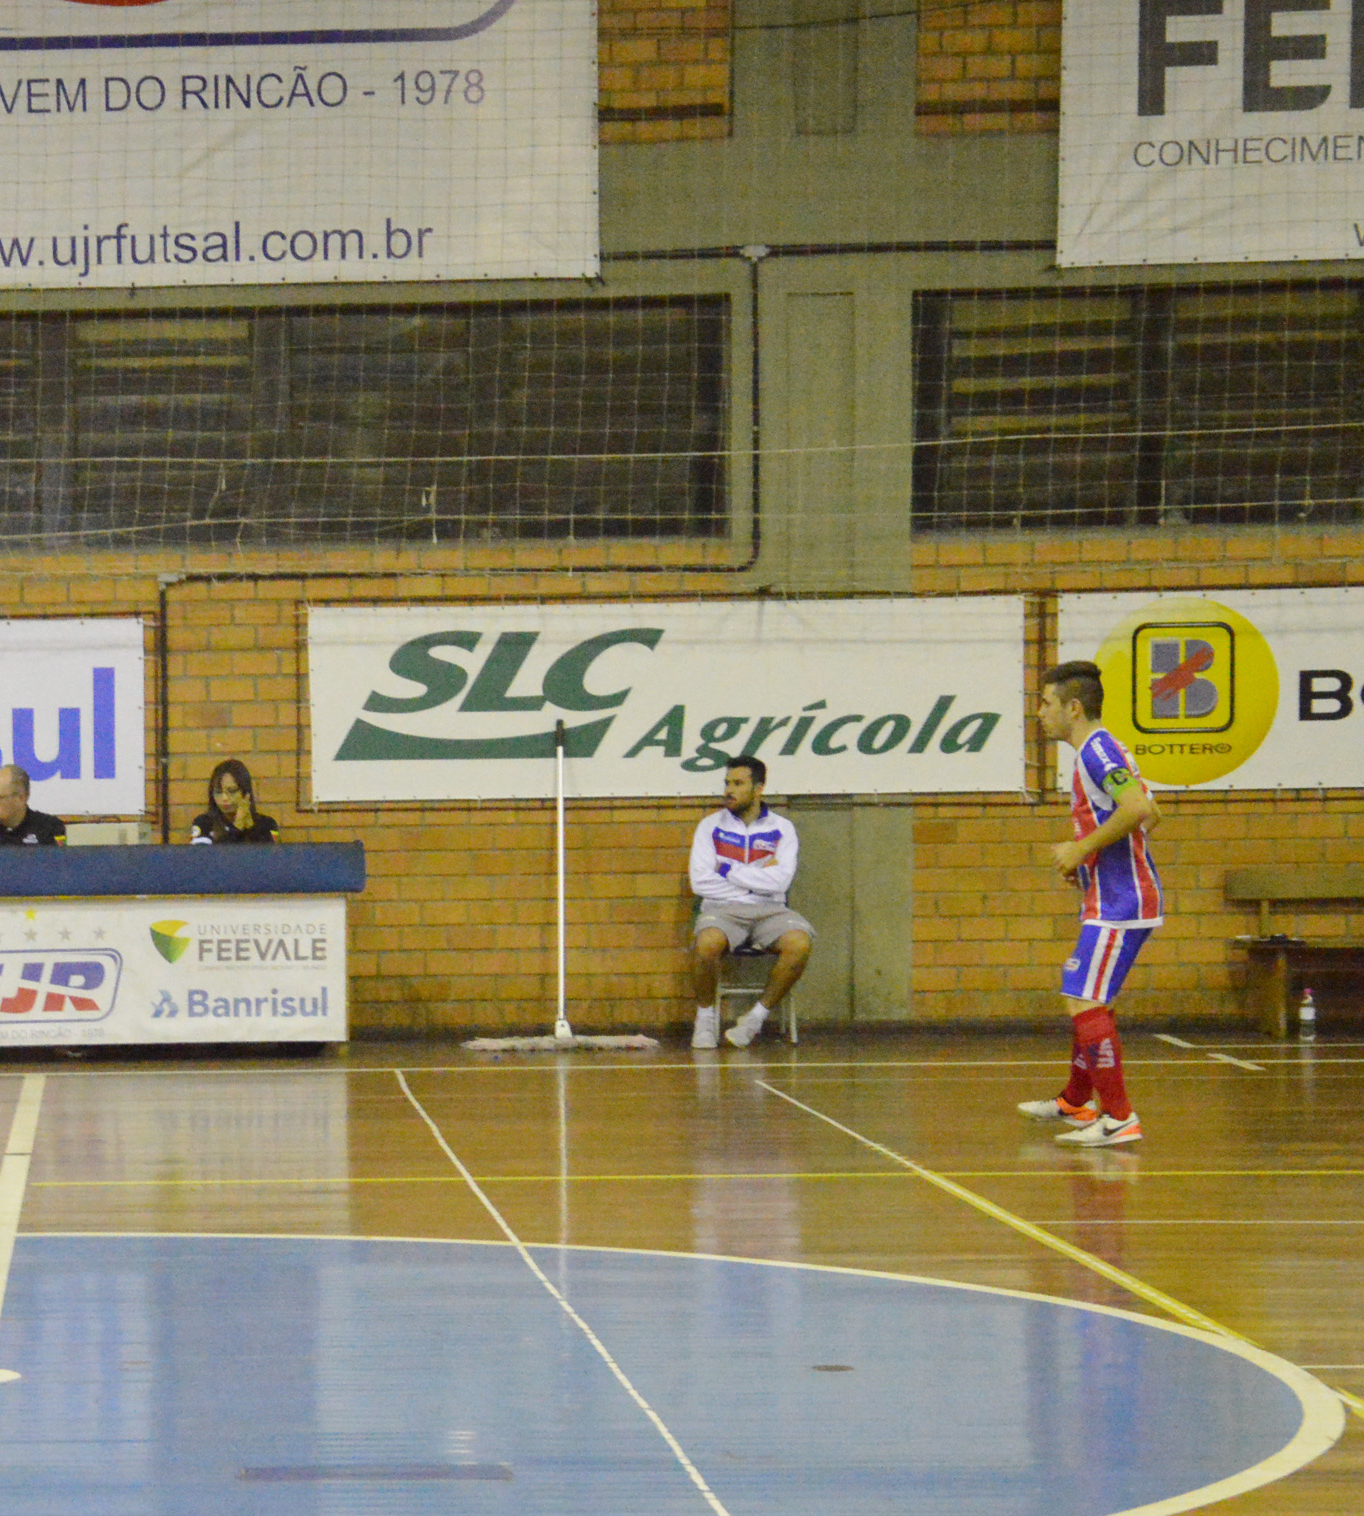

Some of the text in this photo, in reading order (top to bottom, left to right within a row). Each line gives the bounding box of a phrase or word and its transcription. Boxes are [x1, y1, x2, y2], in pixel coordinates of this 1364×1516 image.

[1137, 0, 1364, 116] FE
[104, 76, 166, 112] DO
[181, 65, 348, 110] RINCÃO
[392, 69, 486, 105] 1978
[362, 627, 666, 713] SLC
[1298, 668, 1364, 722] B
[622, 694, 1003, 773] Agrícola
[197, 923, 328, 936] UNIVERSIDADE
[198, 938, 328, 962] FEEVALE
[187, 986, 329, 1018] Banrisul
